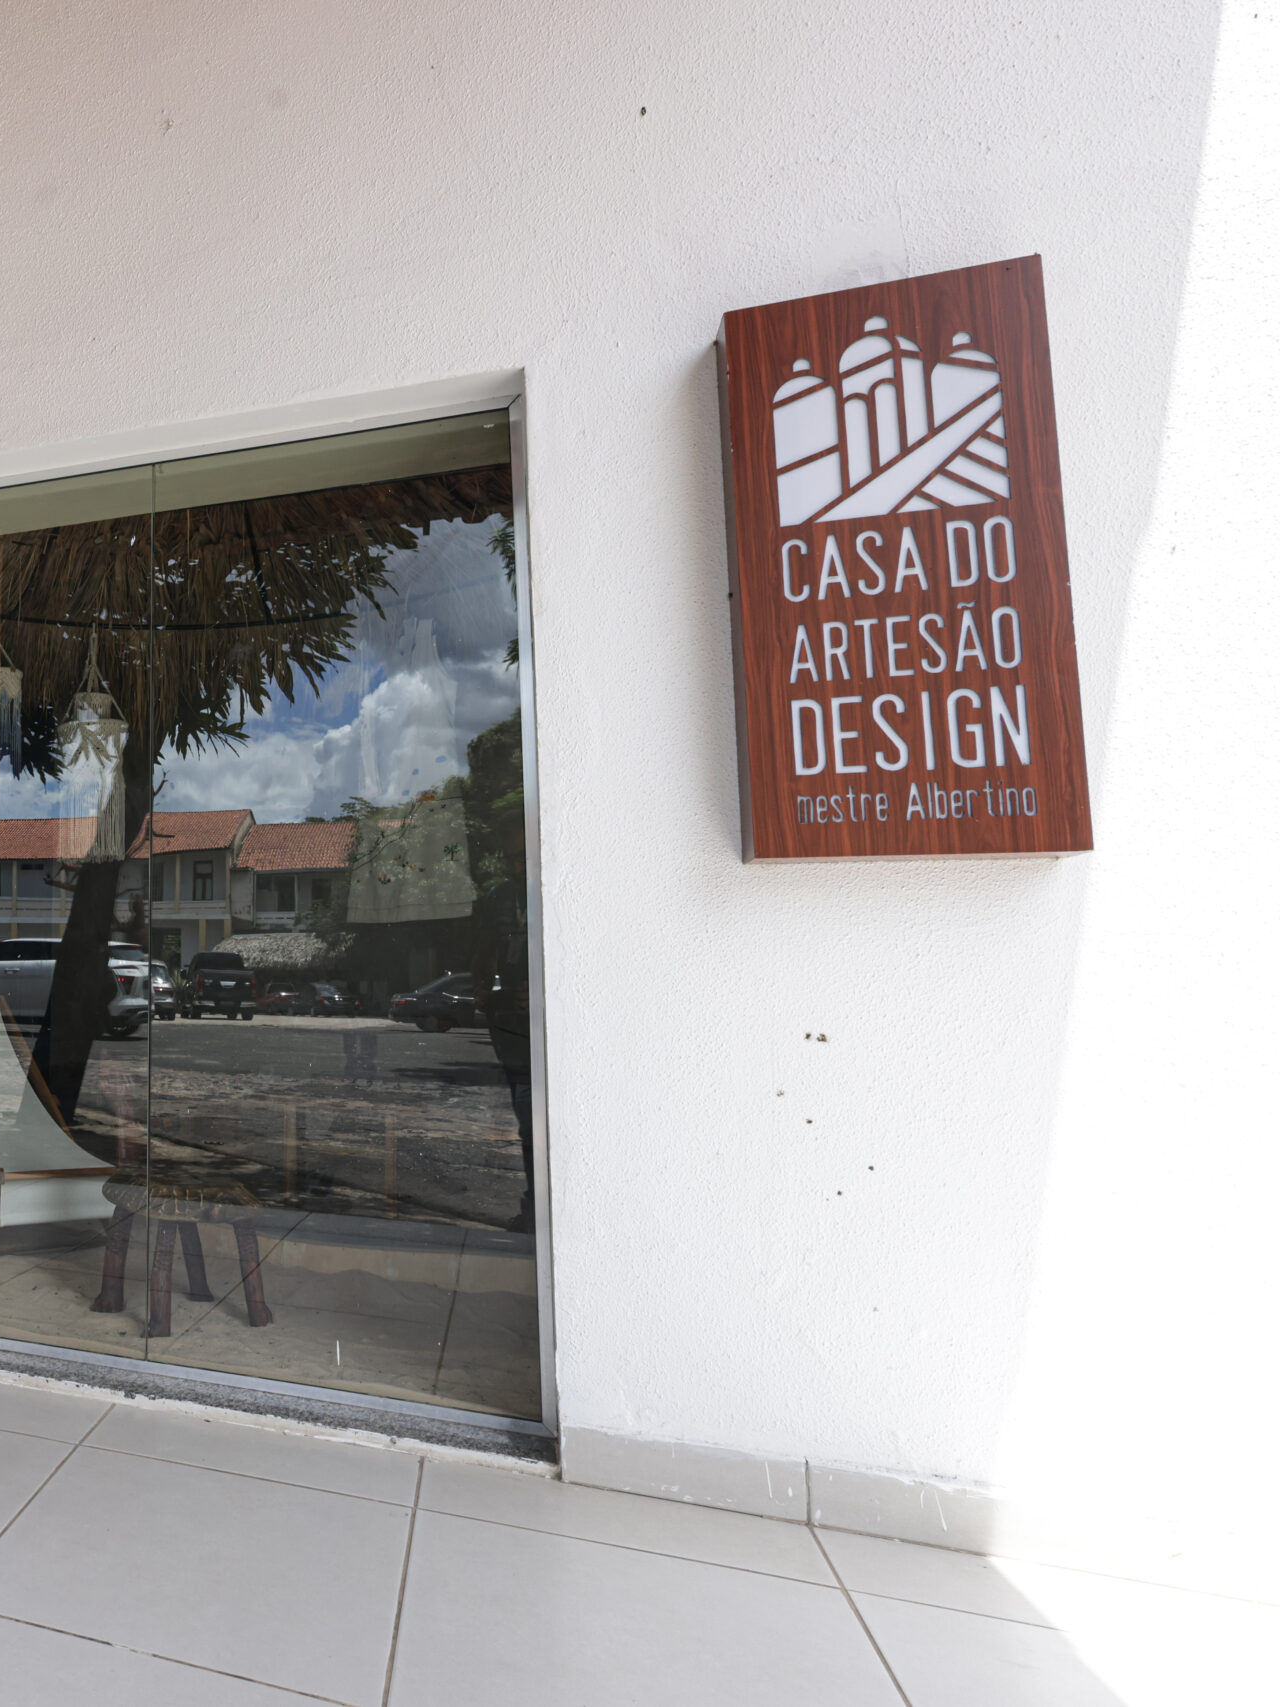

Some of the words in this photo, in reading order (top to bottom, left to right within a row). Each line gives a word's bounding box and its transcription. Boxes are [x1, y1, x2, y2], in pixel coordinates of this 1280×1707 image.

[781, 526, 928, 603] CASA
[946, 515, 1018, 588] DO
[789, 601, 1023, 684] ARTESÃO
[790, 684, 1032, 776] DESIGN
[797, 785, 889, 824] mestre
[906, 779, 1038, 821] Albertino
